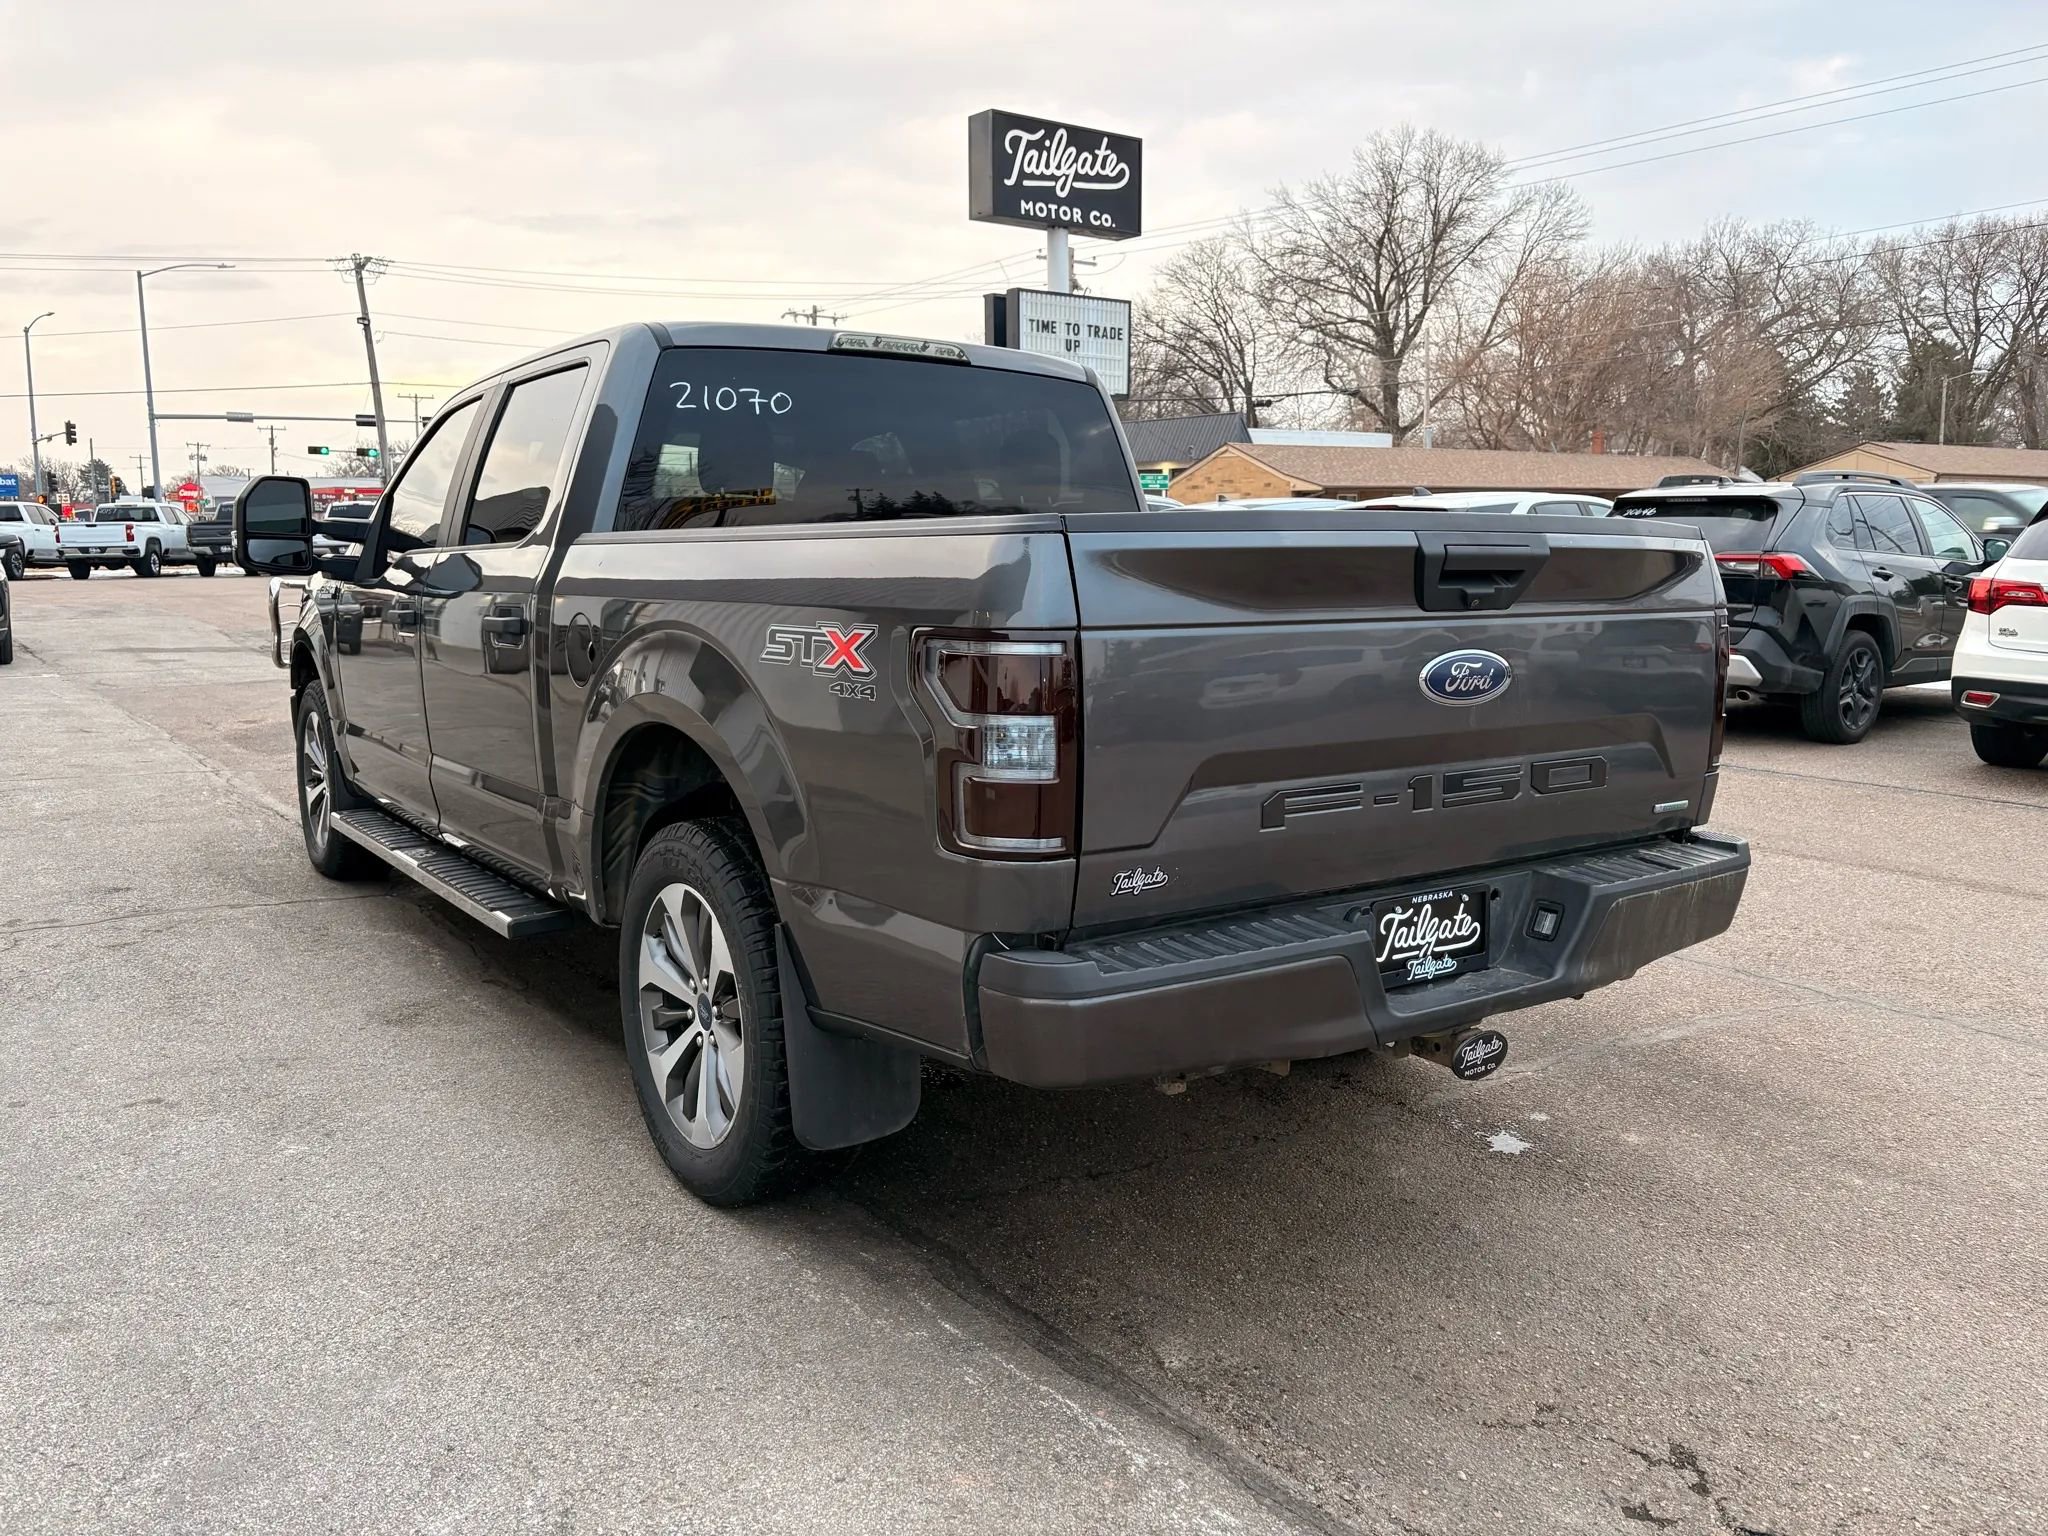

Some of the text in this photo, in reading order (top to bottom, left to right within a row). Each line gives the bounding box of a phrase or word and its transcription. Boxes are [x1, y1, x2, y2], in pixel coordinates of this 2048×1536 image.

[1004, 127, 1130, 198] Tailgate
[1020, 199, 1083, 223] MOTOR
[1029, 318, 1124, 341] TIME TO TRADE
[1065, 338, 1081, 353] UP
[669, 381, 792, 415] 21070
[759, 620, 879, 681] STX
[1444, 661, 1496, 693] Ford
[1259, 755, 1608, 832] F-150
[1110, 866, 1169, 896] Tailgate
[1411, 890, 1453, 904] NEBRASKA
[1376, 902, 1481, 963] Tailgate
[1407, 952, 1457, 981] Tailgate
[1460, 1035, 1503, 1069] Tailgate
[1464, 1065, 1486, 1077] MOTOR
